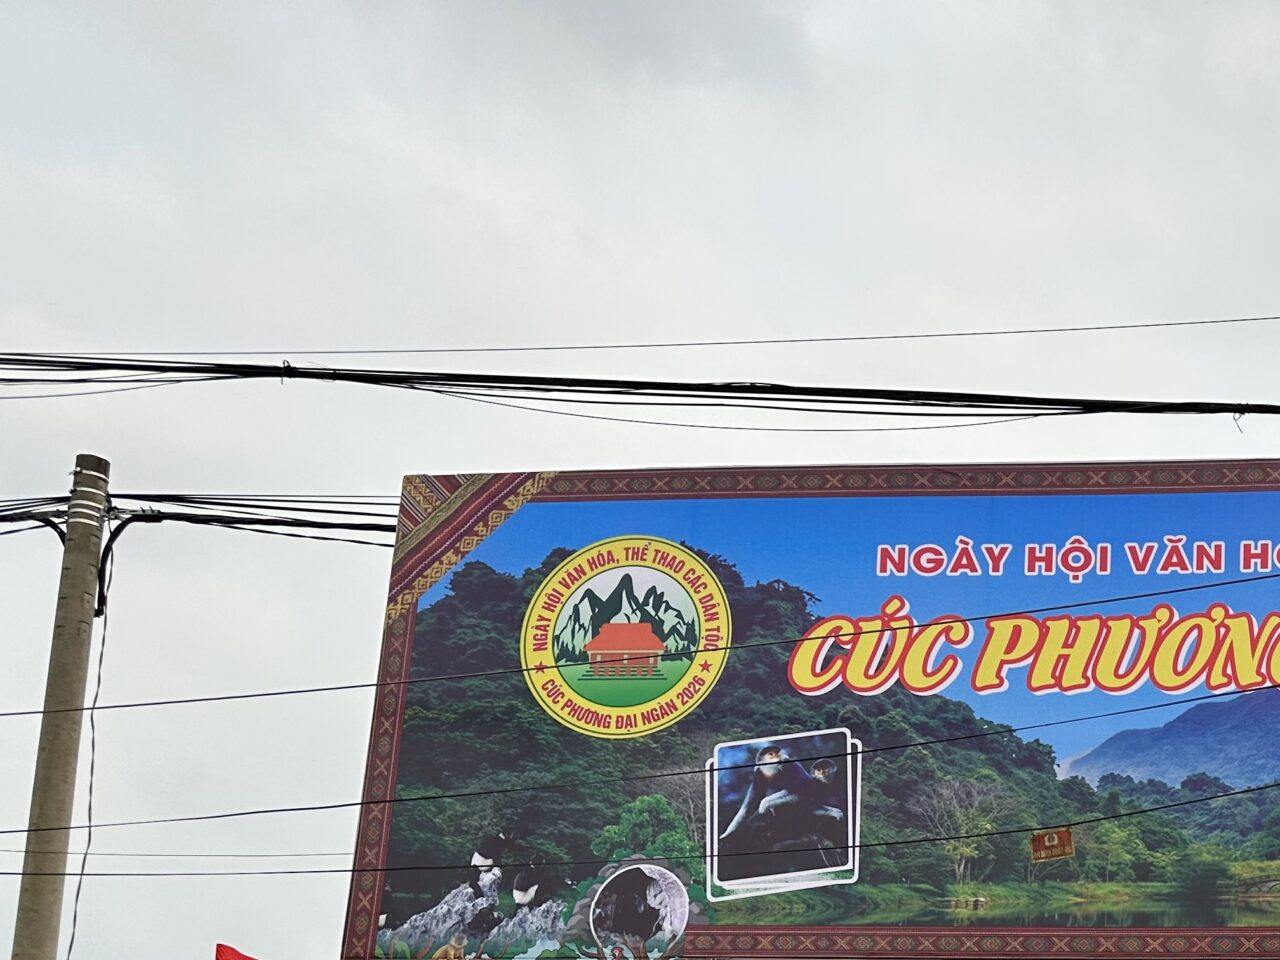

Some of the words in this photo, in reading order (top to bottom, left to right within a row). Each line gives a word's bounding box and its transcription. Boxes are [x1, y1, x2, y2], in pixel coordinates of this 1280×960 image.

[587, 549, 620, 571] HÓA,
[624, 542, 652, 562] THỂ
[651, 548, 686, 574] THAO
[876, 536, 1011, 577] NGÀY
[1024, 536, 1111, 583] HỘI
[1128, 535, 1225, 575] VĂN
[558, 564, 588, 590] VĂN
[681, 567, 708, 594] CÁC
[541, 588, 565, 614] HỘI
[698, 592, 721, 623] DÂN
[532, 615, 552, 652] NGÀY
[786, 594, 969, 698] CÚC
[541, 678, 565, 705] CÚC
[560, 698, 613, 730] PHƯƠNG
[615, 715, 639, 733] ĐẠI
[641, 698, 679, 726] NGÀN
[676, 675, 706, 707] 2026
